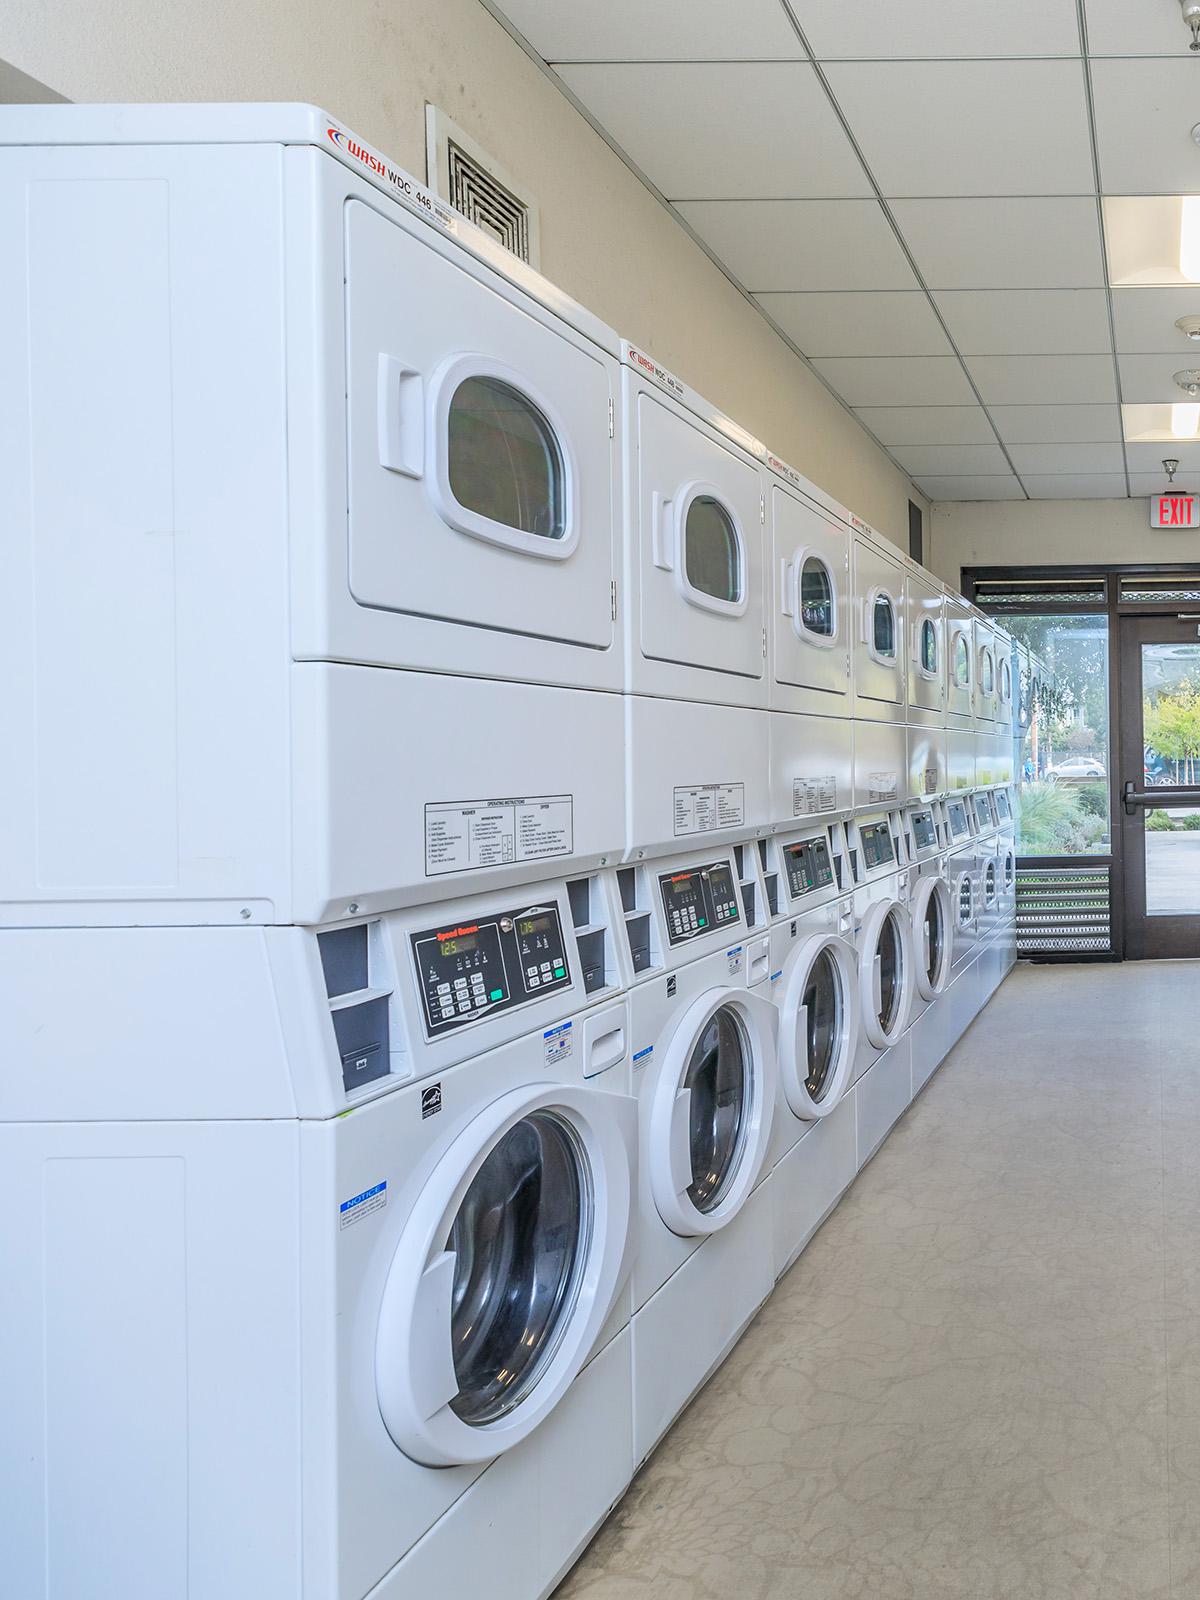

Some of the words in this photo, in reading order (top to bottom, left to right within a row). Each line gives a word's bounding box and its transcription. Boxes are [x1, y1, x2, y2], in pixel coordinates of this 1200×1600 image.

[347, 139, 386, 177] WASH
[387, 168, 411, 195] WDC
[1159, 498, 1194, 525] EXIT
[436, 930, 457, 941] Speed
[458, 926, 479, 936] Queen
[347, 1186, 380, 1208] NOTICE
